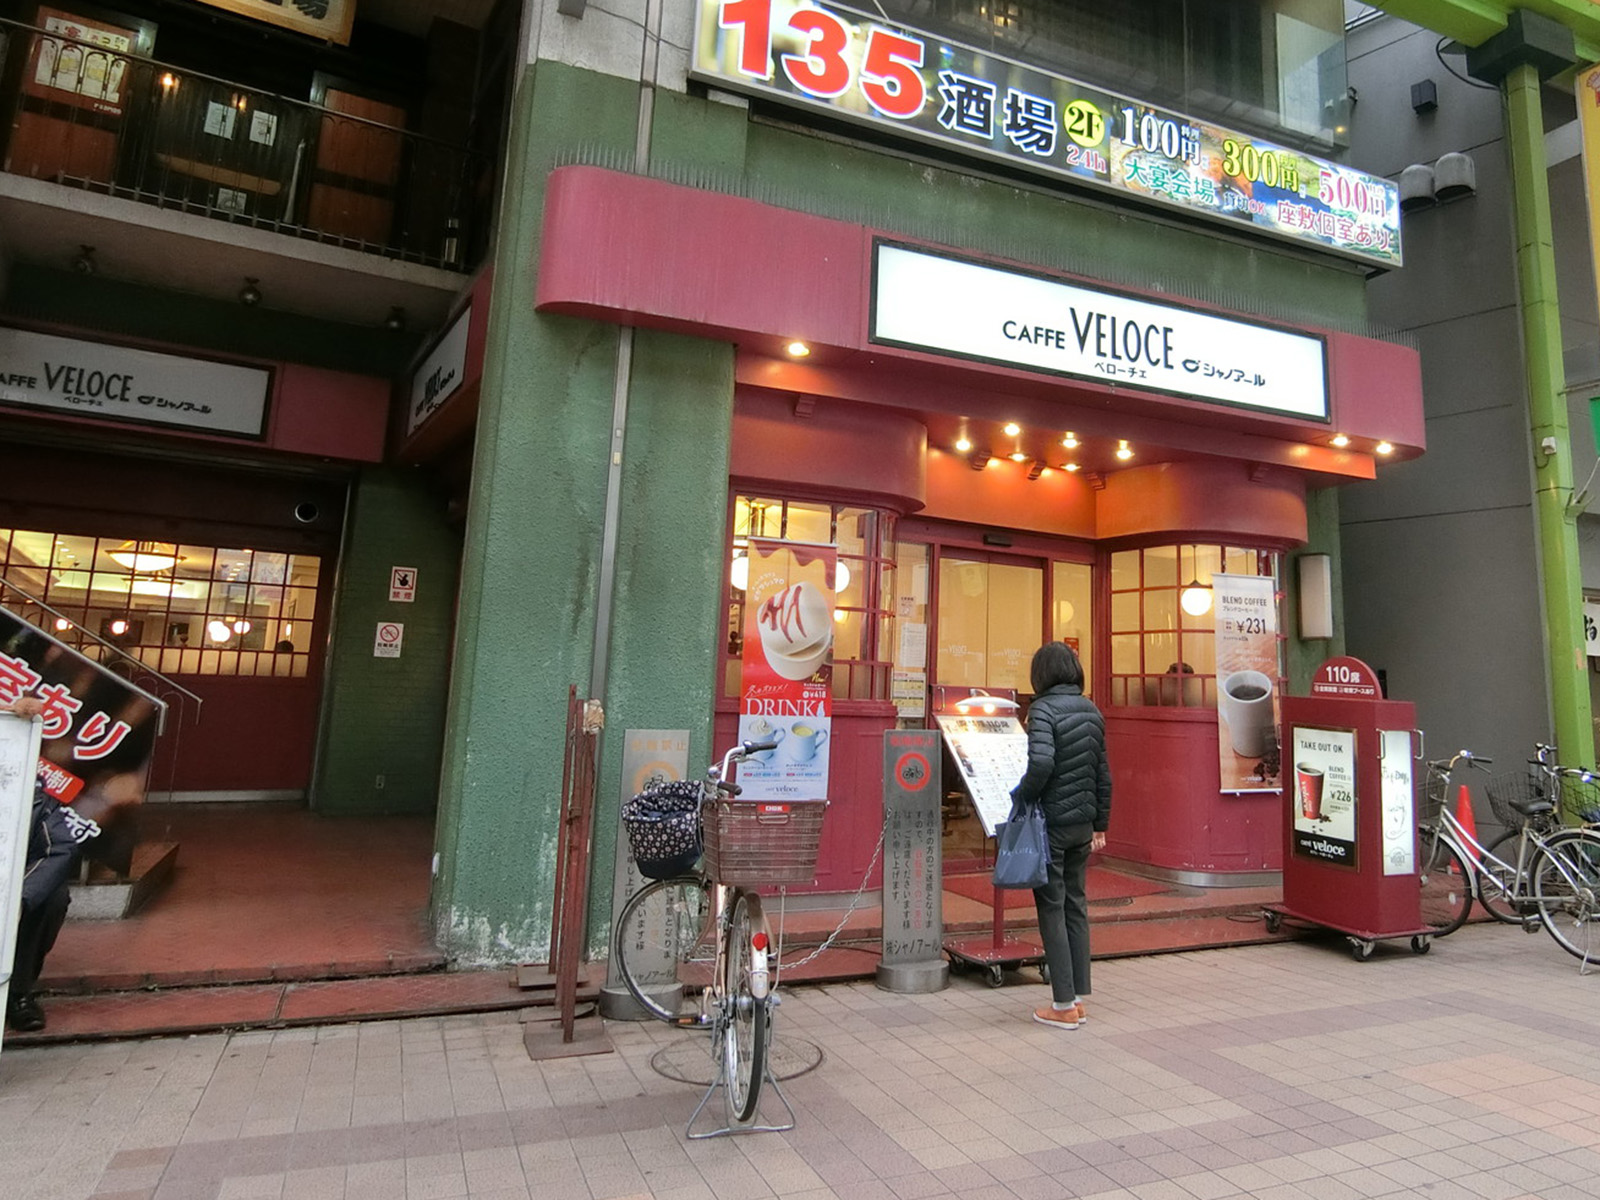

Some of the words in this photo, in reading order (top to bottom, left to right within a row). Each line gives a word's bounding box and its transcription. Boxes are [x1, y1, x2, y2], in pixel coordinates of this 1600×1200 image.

[718, 0, 927, 119] 135
[936, 68, 1058, 157] 酒場
[1067, 105, 1103, 141] 2F
[1120, 105, 1201, 166] 100円
[1065, 143, 1107, 174] 24h
[1222, 138, 1300, 193] 300円
[1123, 158, 1216, 206] 大宴会場
[1320, 170, 1387, 219] 500円
[1276, 200, 1390, 251] 座敷個室あり
[1002, 320, 1066, 350] CAFFE
[1069, 306, 1174, 370] VELOCE
[1203, 362, 1267, 388] シャノアール
[44, 361, 134, 402] VELOCE
[156, 398, 212, 415] シャノアール
[1094, 361, 1148, 380] ベローチェ
[64, 396, 104, 408] ベローチェ
[1222, 596, 1243, 605] BLEND
[1244, 597, 1267, 607] COFFEE
[1300, 740, 1316, 751] TAKE
[1317, 743, 1332, 752] OUT
[1333, 744, 1343, 753] OK
[1328, 765, 1345, 773] BLEND
[1312, 839, 1346, 857] veloce
